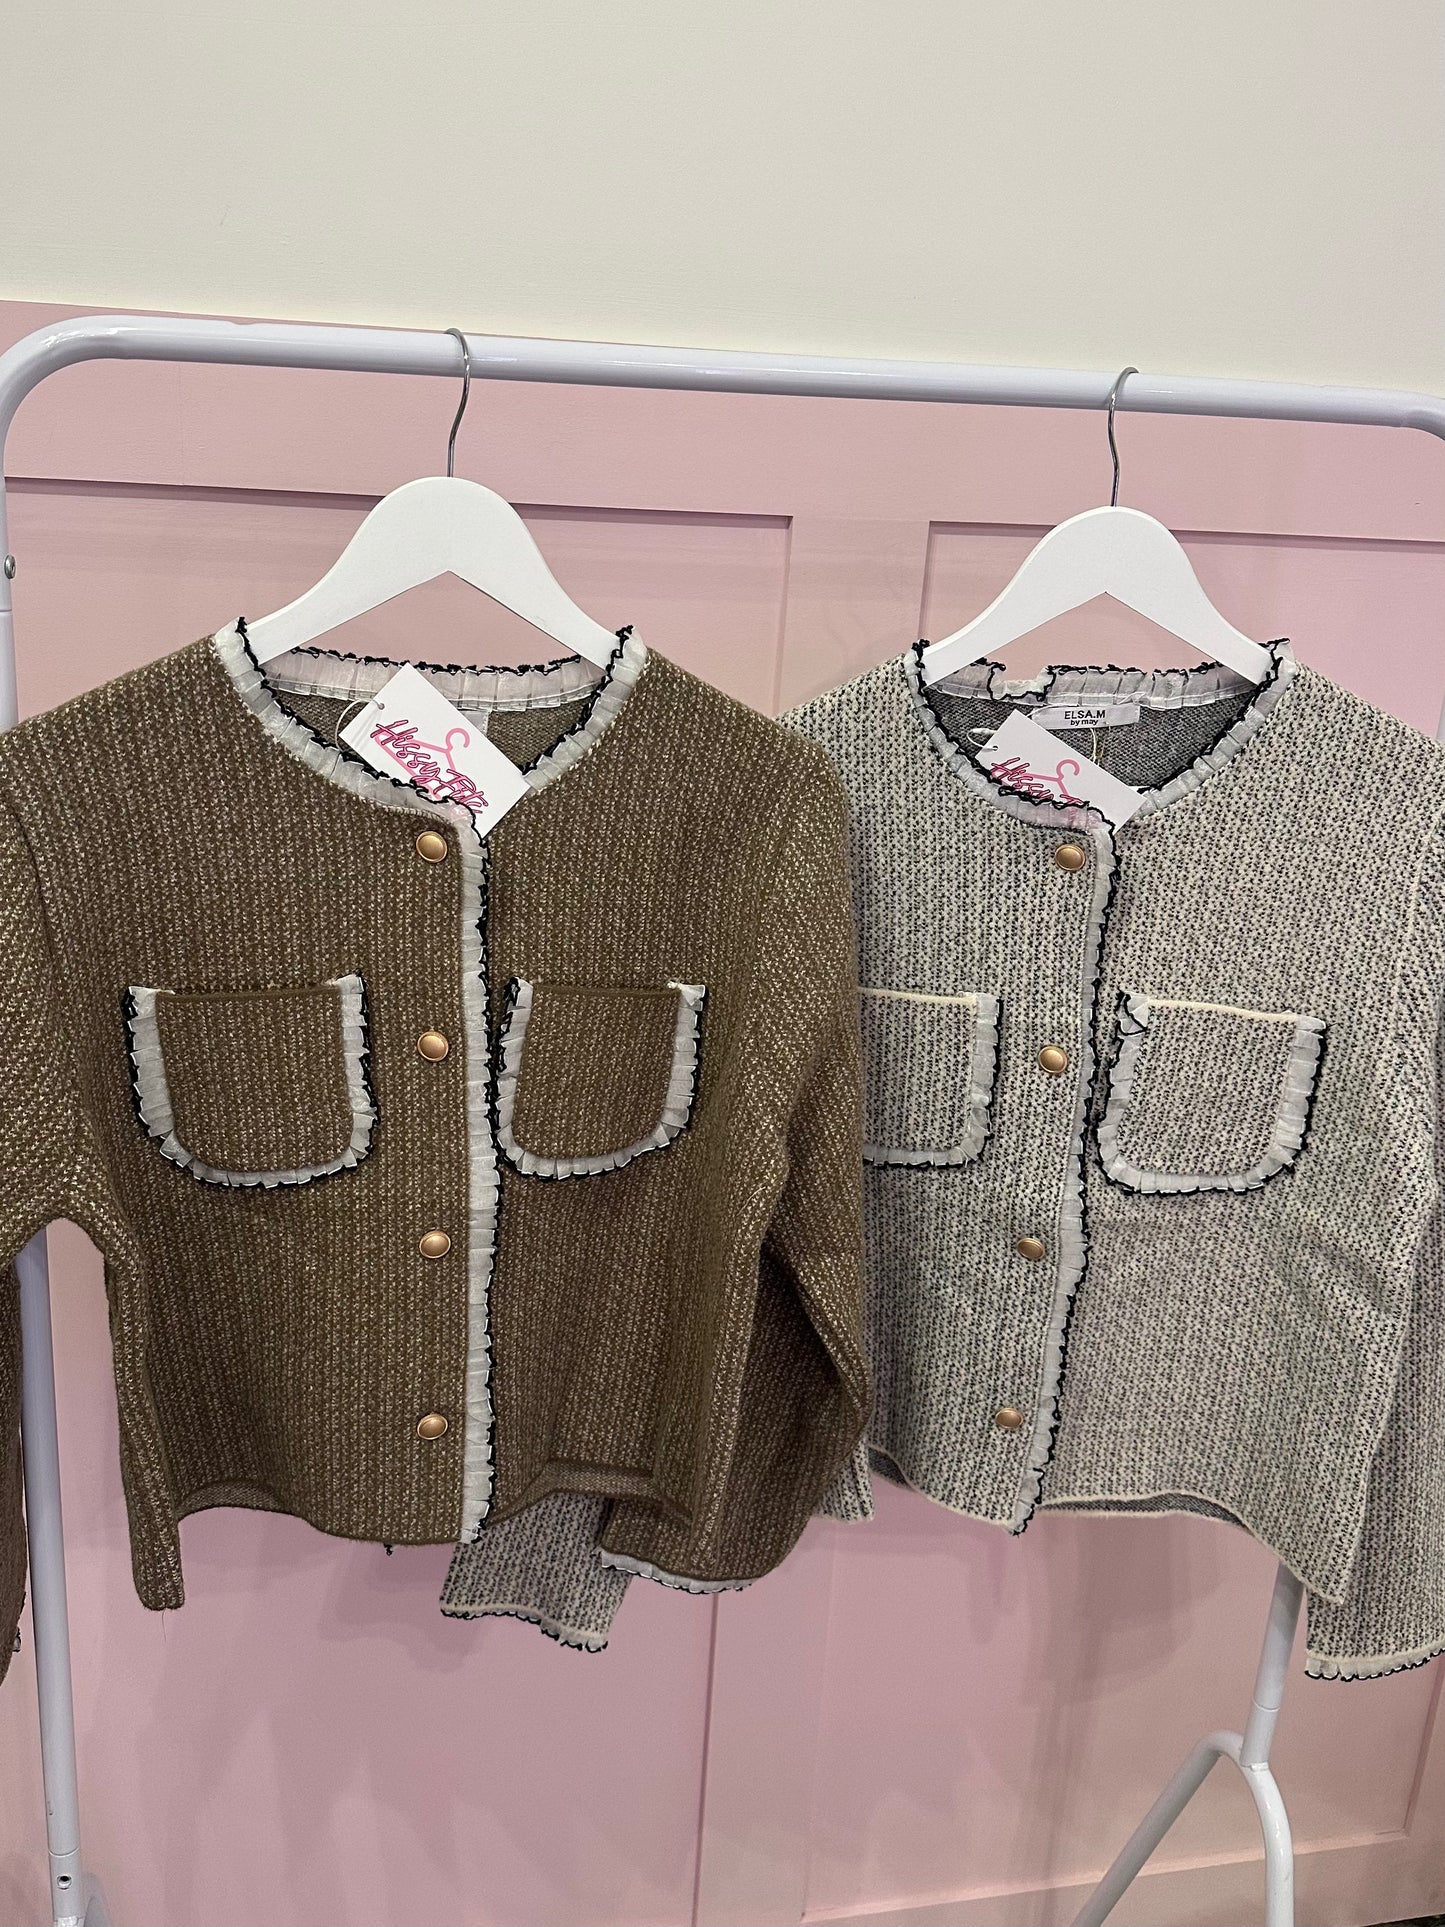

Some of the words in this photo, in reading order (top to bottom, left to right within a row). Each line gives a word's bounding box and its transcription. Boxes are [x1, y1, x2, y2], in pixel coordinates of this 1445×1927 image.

[1064, 710, 1106, 720] ELSA.M
[1070, 719, 1080, 727] by
[370, 719, 440, 784] Hissy
